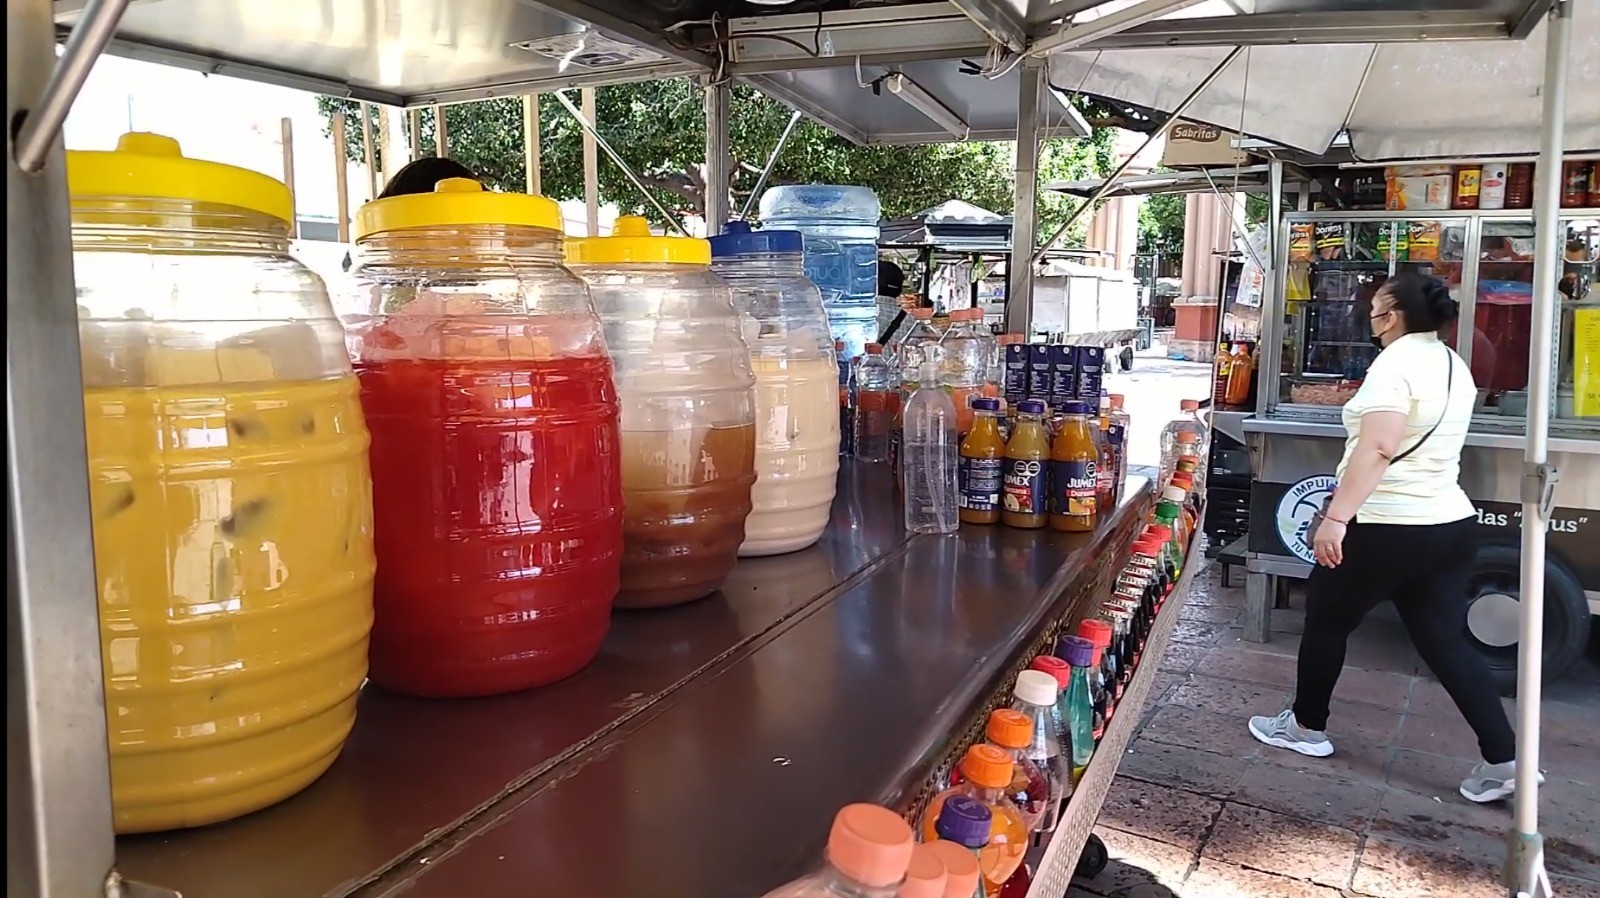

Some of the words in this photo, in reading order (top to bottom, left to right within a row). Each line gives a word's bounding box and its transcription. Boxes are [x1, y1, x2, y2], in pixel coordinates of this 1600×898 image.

[1175, 127, 1217, 139] Sabritas
[1315, 224, 1342, 235] Doritos
[1291, 541, 1304, 553] TU
